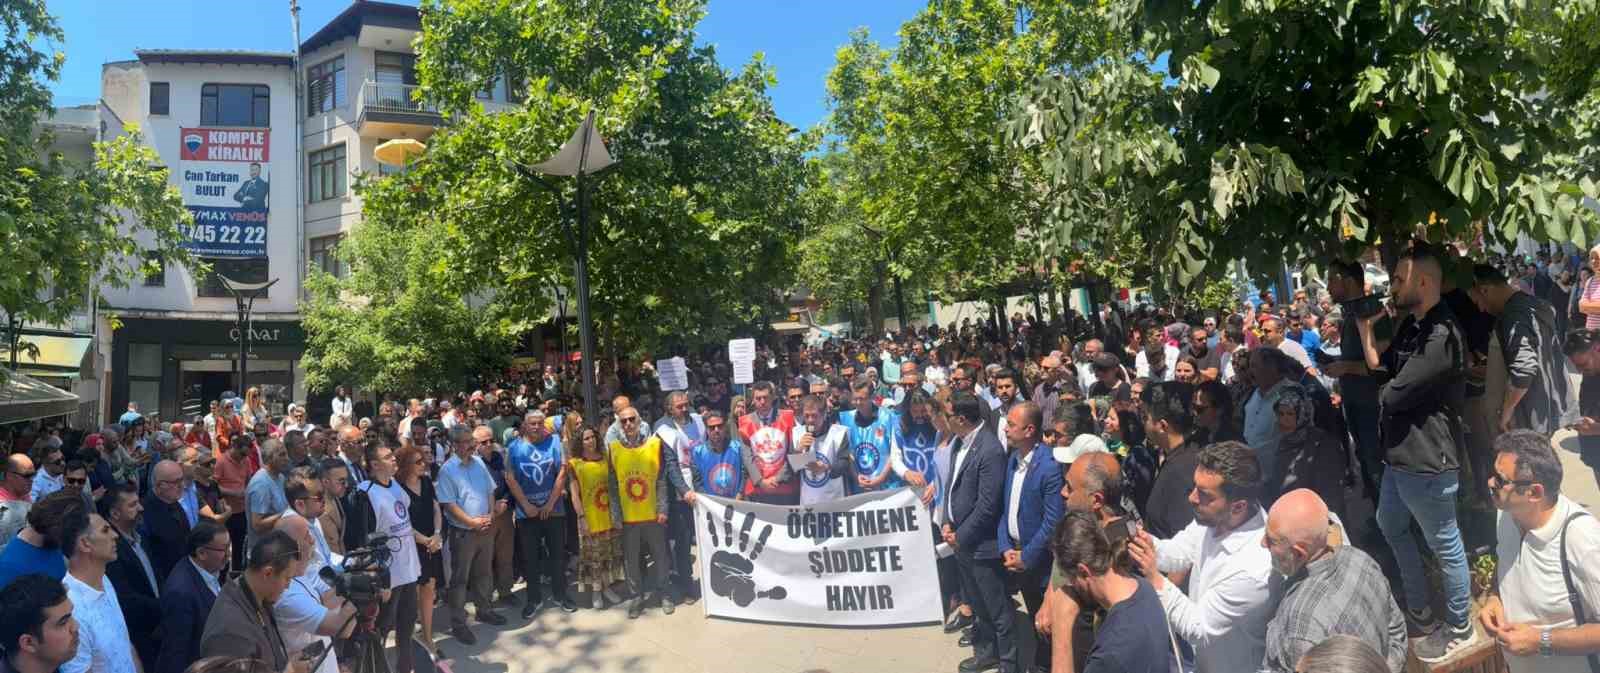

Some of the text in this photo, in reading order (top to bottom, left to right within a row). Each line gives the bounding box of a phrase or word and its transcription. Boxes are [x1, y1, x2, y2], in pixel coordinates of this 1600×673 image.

[208, 131, 264, 145] KOMPLE
[207, 145, 263, 160] KİRALIK
[184, 170, 239, 183] Can Tarkan
[195, 185, 226, 196] BULUT
[219, 225, 241, 243] 22
[244, 226, 265, 244] 22
[786, 505, 919, 540] ÖĞRETMENE
[808, 546, 903, 578] ŞİDDETE
[825, 584, 894, 612] HAYIR
